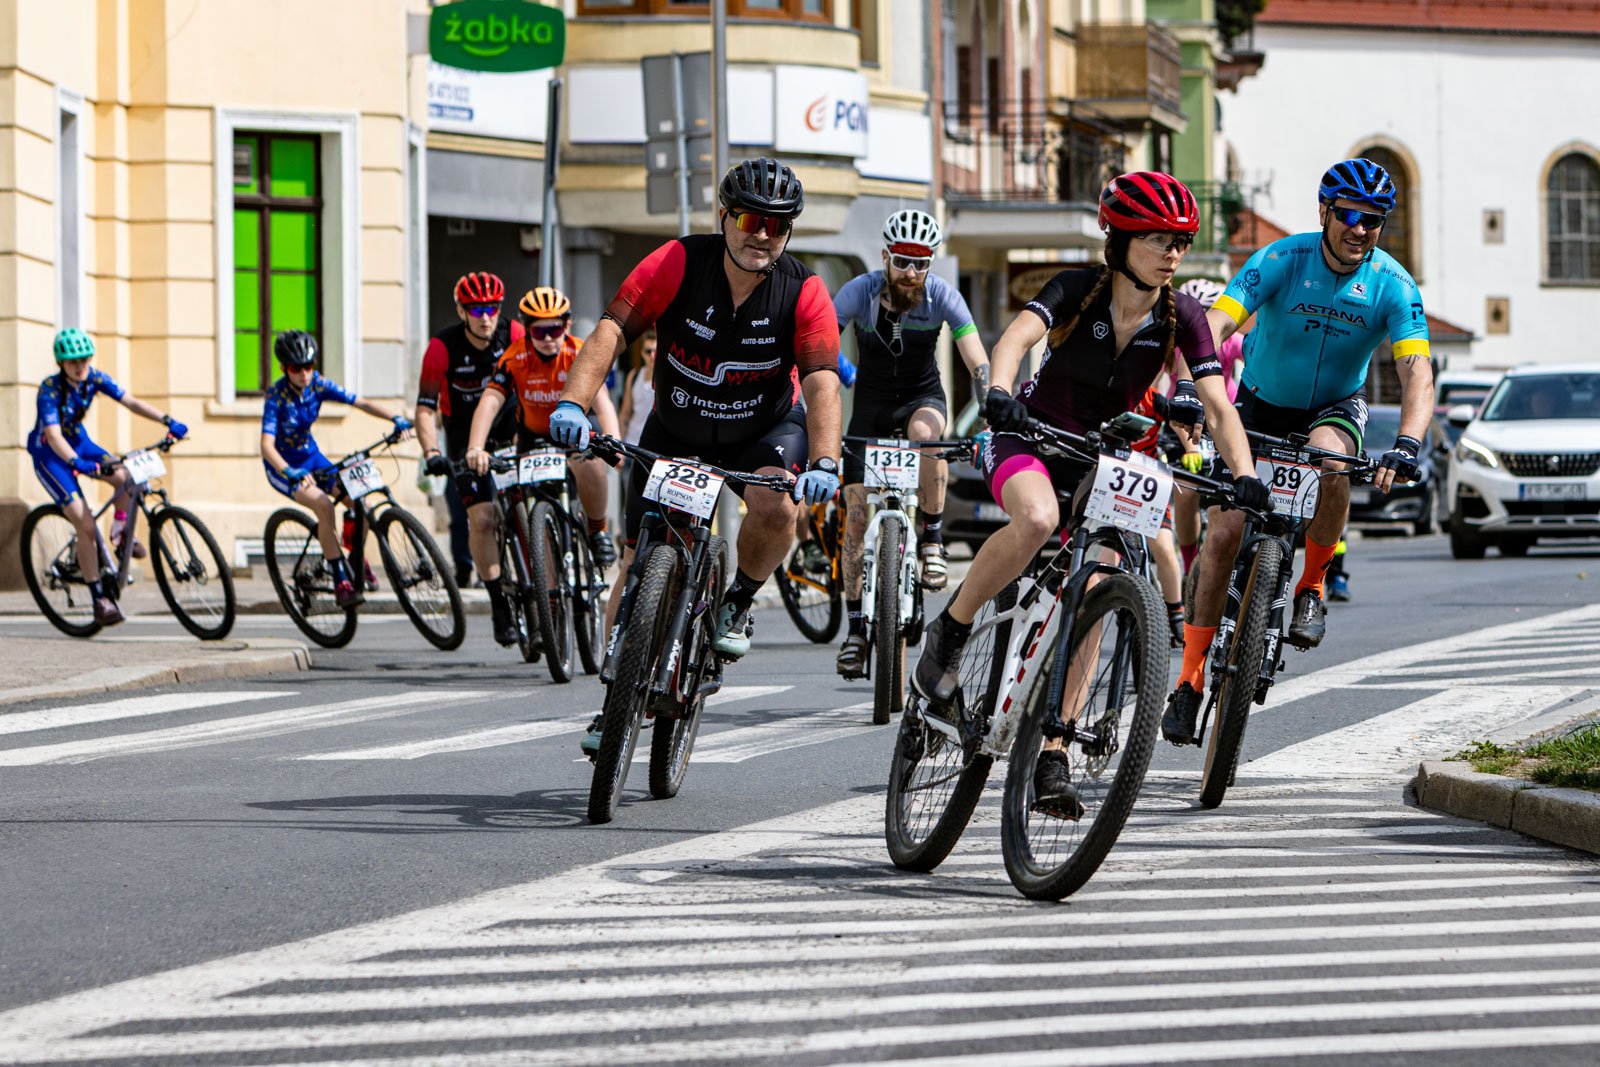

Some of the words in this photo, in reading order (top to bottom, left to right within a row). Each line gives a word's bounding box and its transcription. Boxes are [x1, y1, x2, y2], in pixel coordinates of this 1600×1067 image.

[445, 11, 553, 44] żabka
[1290, 303, 1367, 328] ASTANA
[741, 337, 776, 345] AUTO-GLASS
[669, 341, 714, 377] MAL
[746, 359, 780, 369] DROGOWE
[693, 394, 763, 410] Intro-Graf
[700, 409, 754, 420] Drukarnia
[870, 450, 916, 468] 1312
[665, 464, 710, 489] 328
[1109, 466, 1158, 502] 379
[1274, 466, 1301, 489] 69
[666, 488, 693, 502] ROPSON
